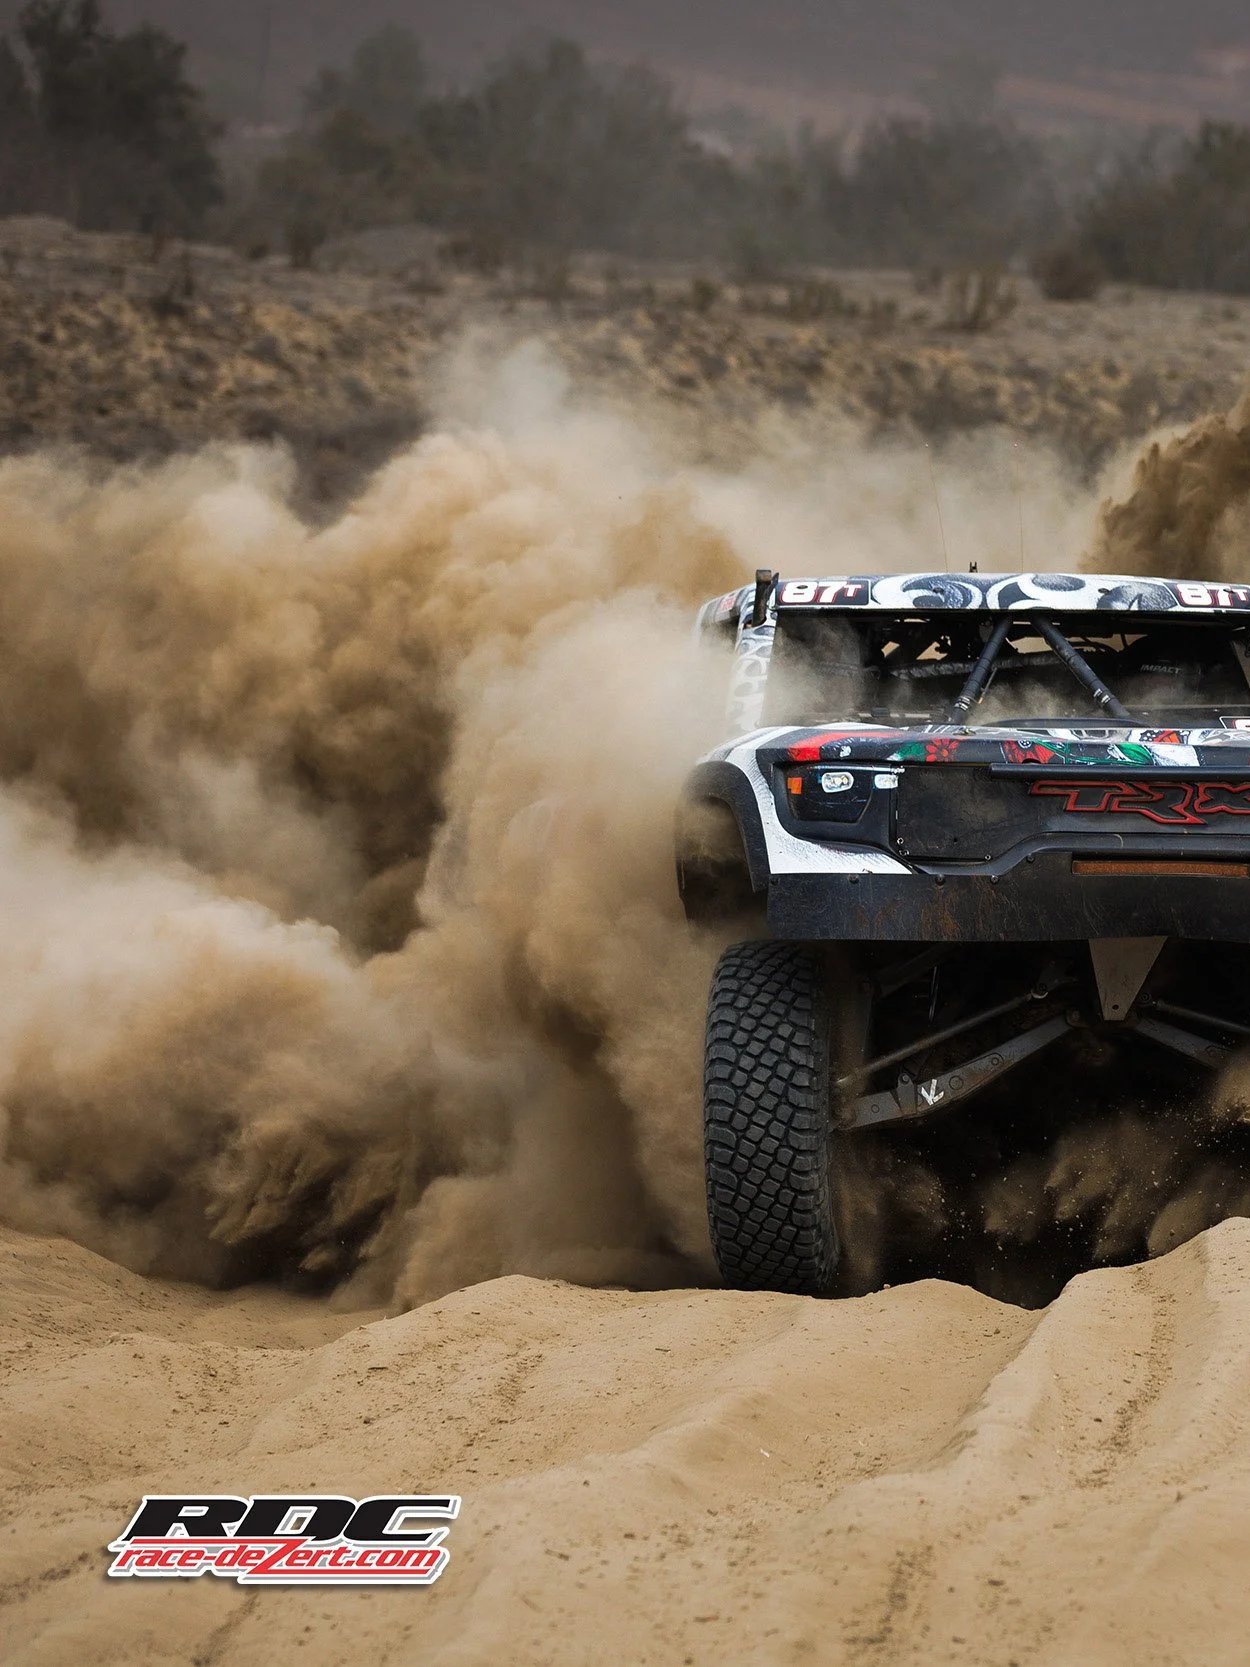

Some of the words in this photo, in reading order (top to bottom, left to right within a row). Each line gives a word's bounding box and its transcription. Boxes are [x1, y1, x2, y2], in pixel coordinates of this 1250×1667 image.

[780, 580, 865, 604] 87T
[1174, 583, 1249, 606] 87T
[1140, 663, 1181, 674] IMPACT
